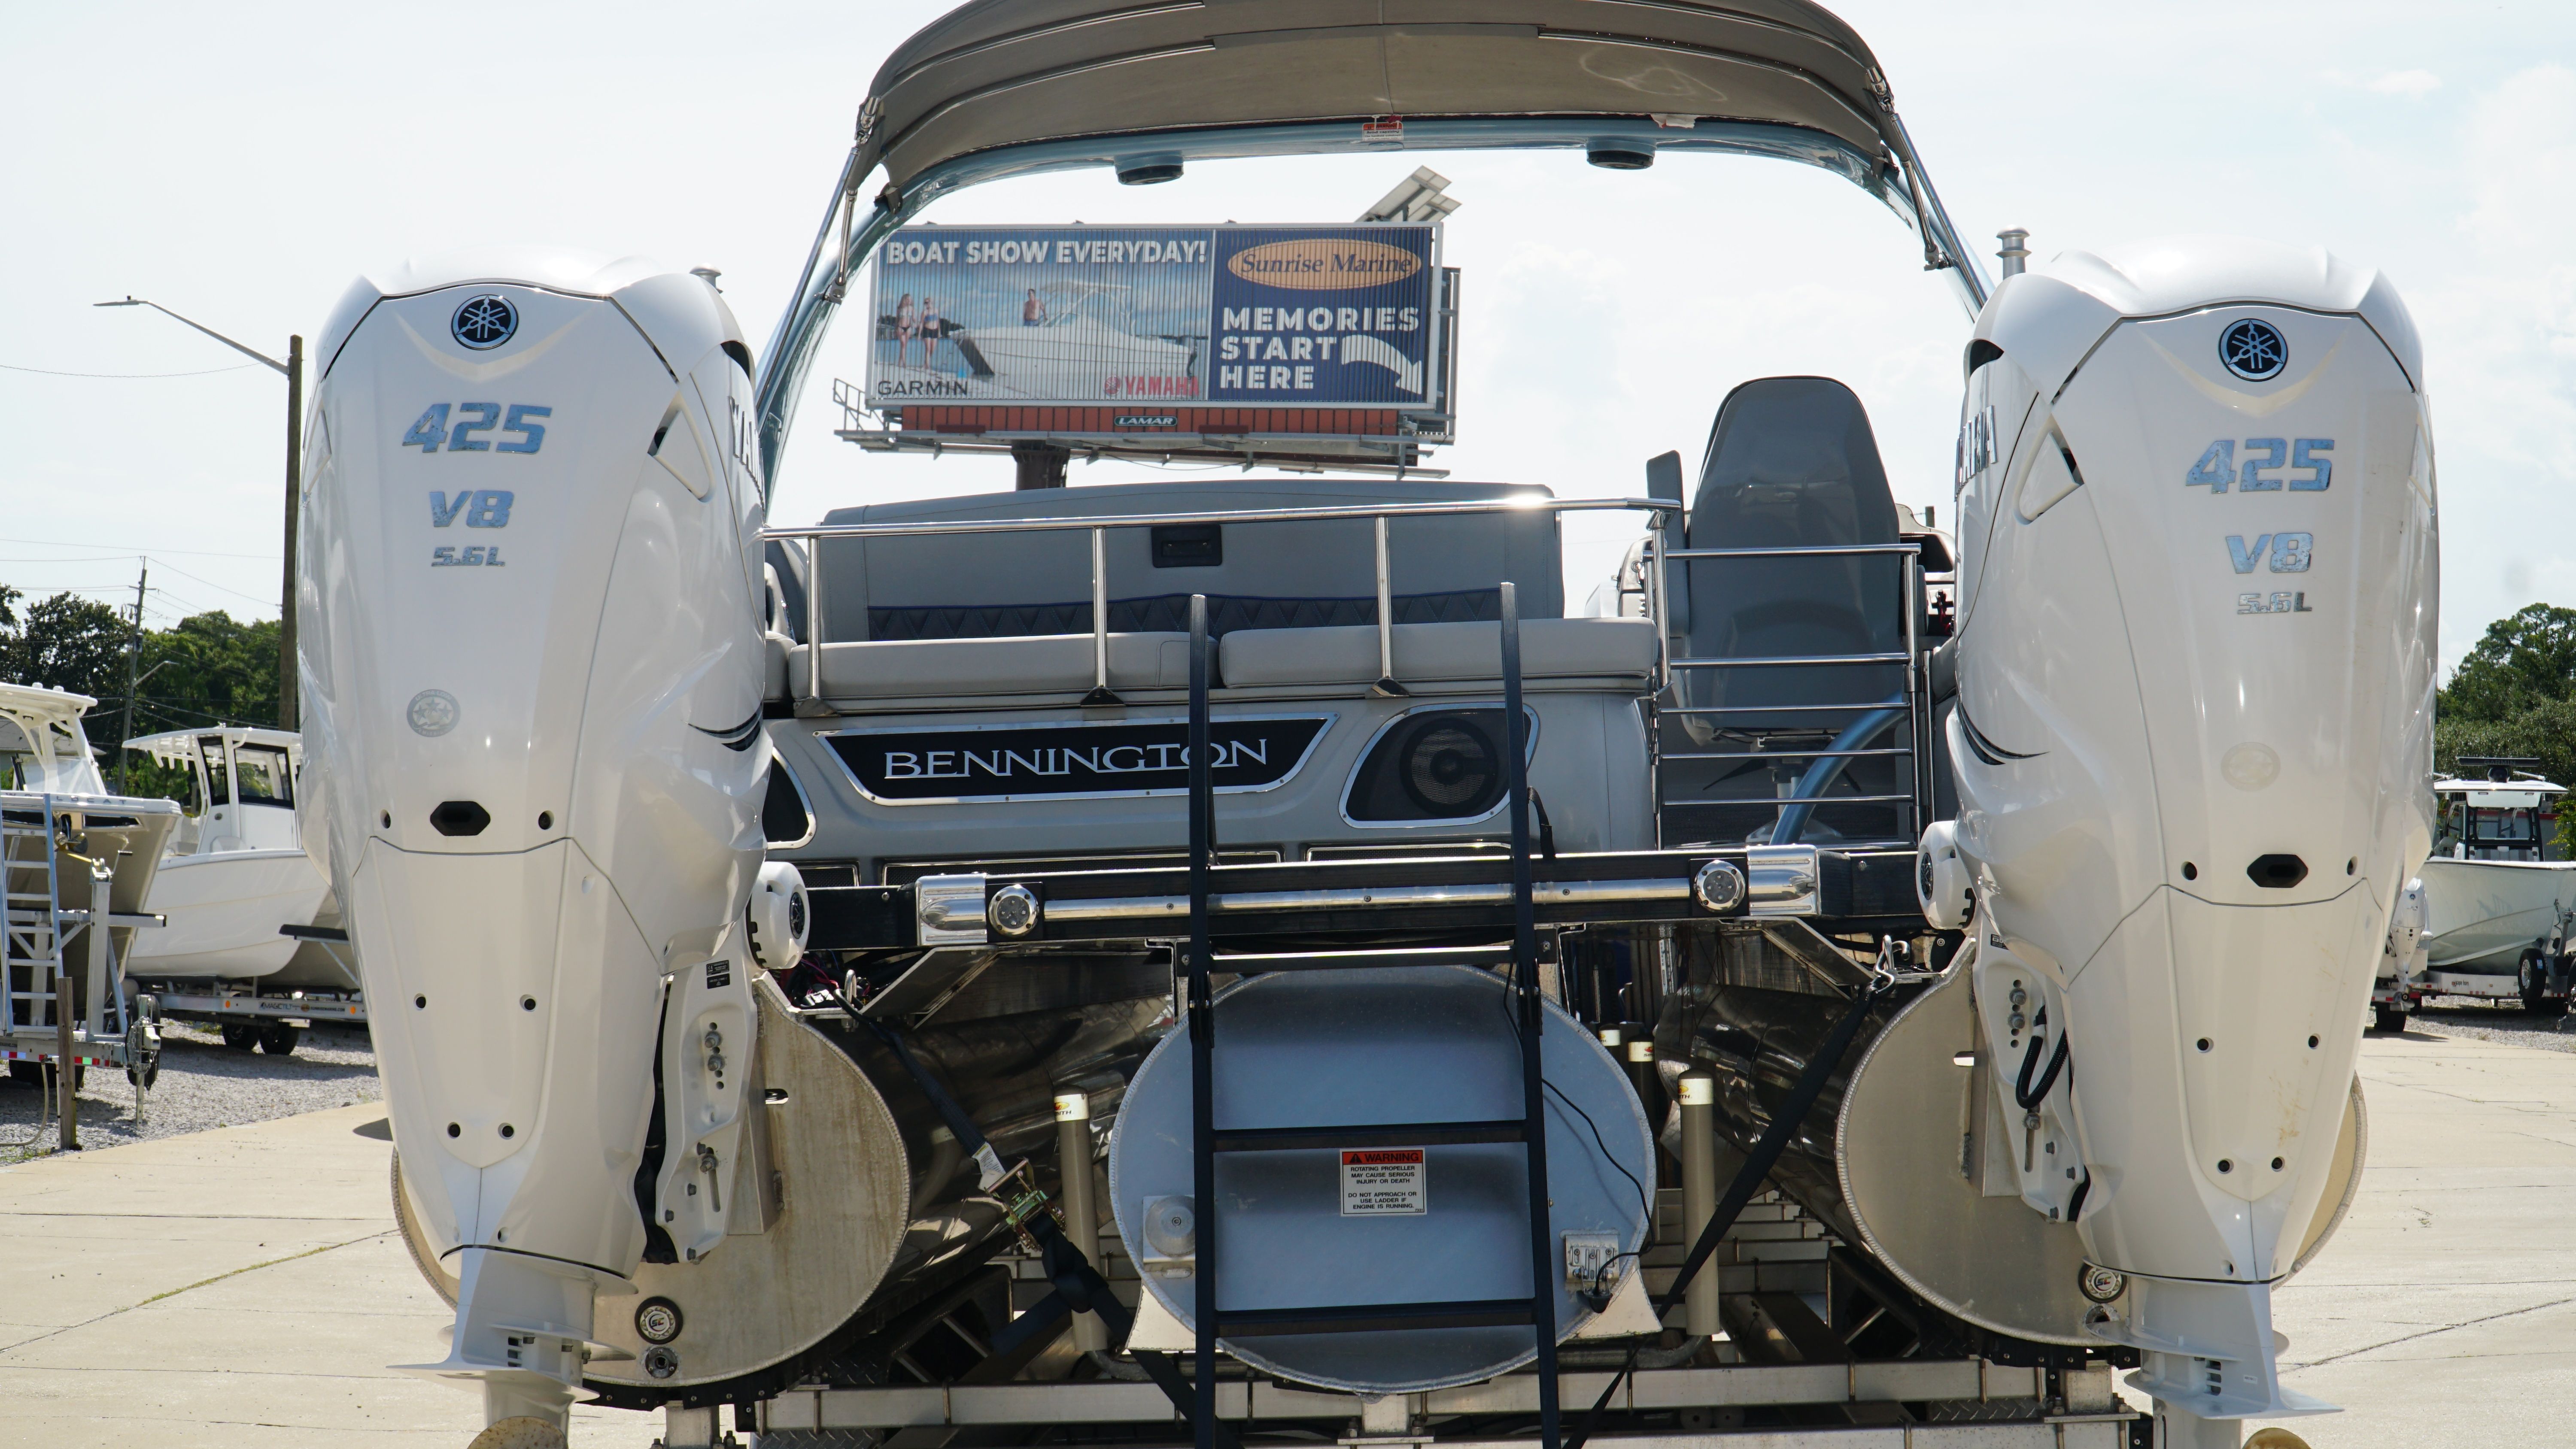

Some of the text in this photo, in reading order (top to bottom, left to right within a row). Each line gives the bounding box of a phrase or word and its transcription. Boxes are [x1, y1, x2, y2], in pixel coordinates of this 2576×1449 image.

[887, 240, 1207, 264] BOAT SHOW EVERYDAY!
[1241, 253, 1413, 273] Sunrise Marine
[1223, 306, 1419, 332] MEMORIES
[1220, 336, 1337, 361] START
[878, 380, 968, 396] GARMIN
[1124, 376, 1200, 396] YAMAHA
[1220, 365, 1314, 389] HERE
[402, 402, 552, 455] 425
[1118, 416, 1173, 426] LAMAR
[2185, 438, 2335, 494] 425
[429, 489, 514, 528] V8
[431, 546, 505, 567] 5.6L
[2226, 532, 2313, 574] V8
[2237, 592, 2312, 615] 5.6L
[884, 739, 1267, 779] BENNINGTON
[1364, 1152, 1419, 1162] WARNING
